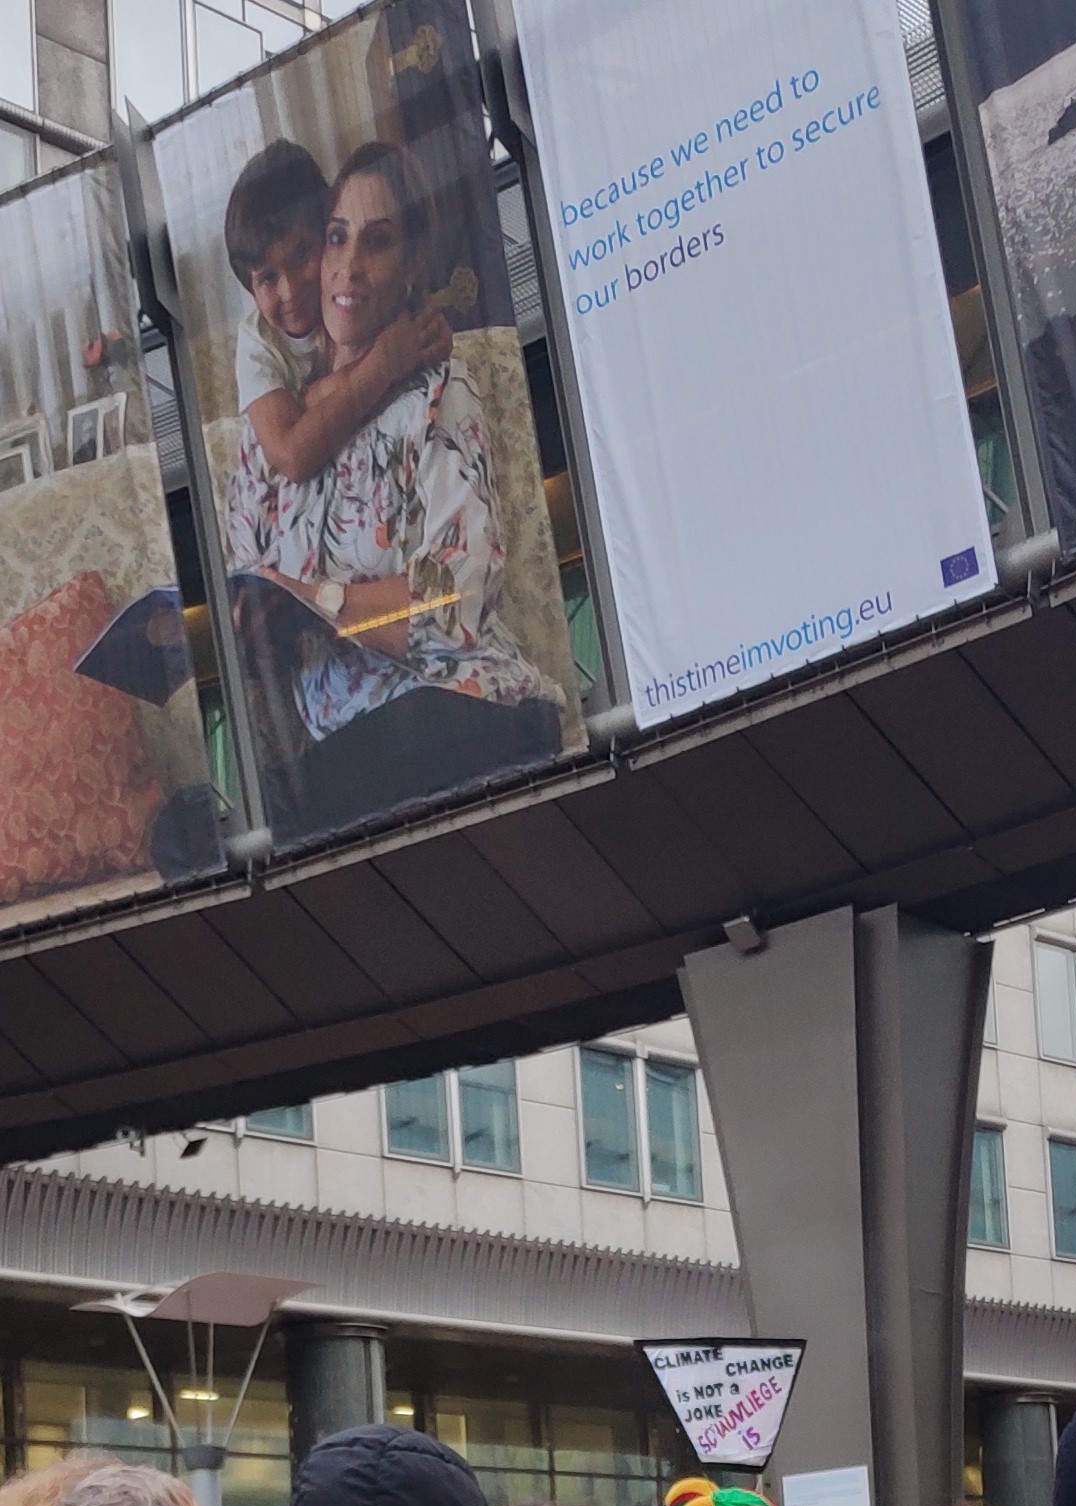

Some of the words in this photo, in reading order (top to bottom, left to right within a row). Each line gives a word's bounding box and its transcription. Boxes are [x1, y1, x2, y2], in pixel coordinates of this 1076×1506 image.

[560, 156, 664, 227] because
[670, 131, 709, 167] we
[715, 79, 783, 142] need
[790, 69, 819, 99] to
[568, 220, 631, 271] work
[636, 157, 749, 236] together
[756, 140, 784, 170] to
[791, 85, 881, 152] secure
[576, 278, 618, 315] our
[624, 223, 725, 292] borders
[645, 591, 892, 708] thistimeimvoting.eu
[654, 1348, 724, 1370] CLIMATE
[725, 1354, 794, 1377] CHANGE
[676, 1390, 690, 1403] is
[694, 1383, 724, 1398] NOT
[685, 1404, 723, 1423] JOKE
